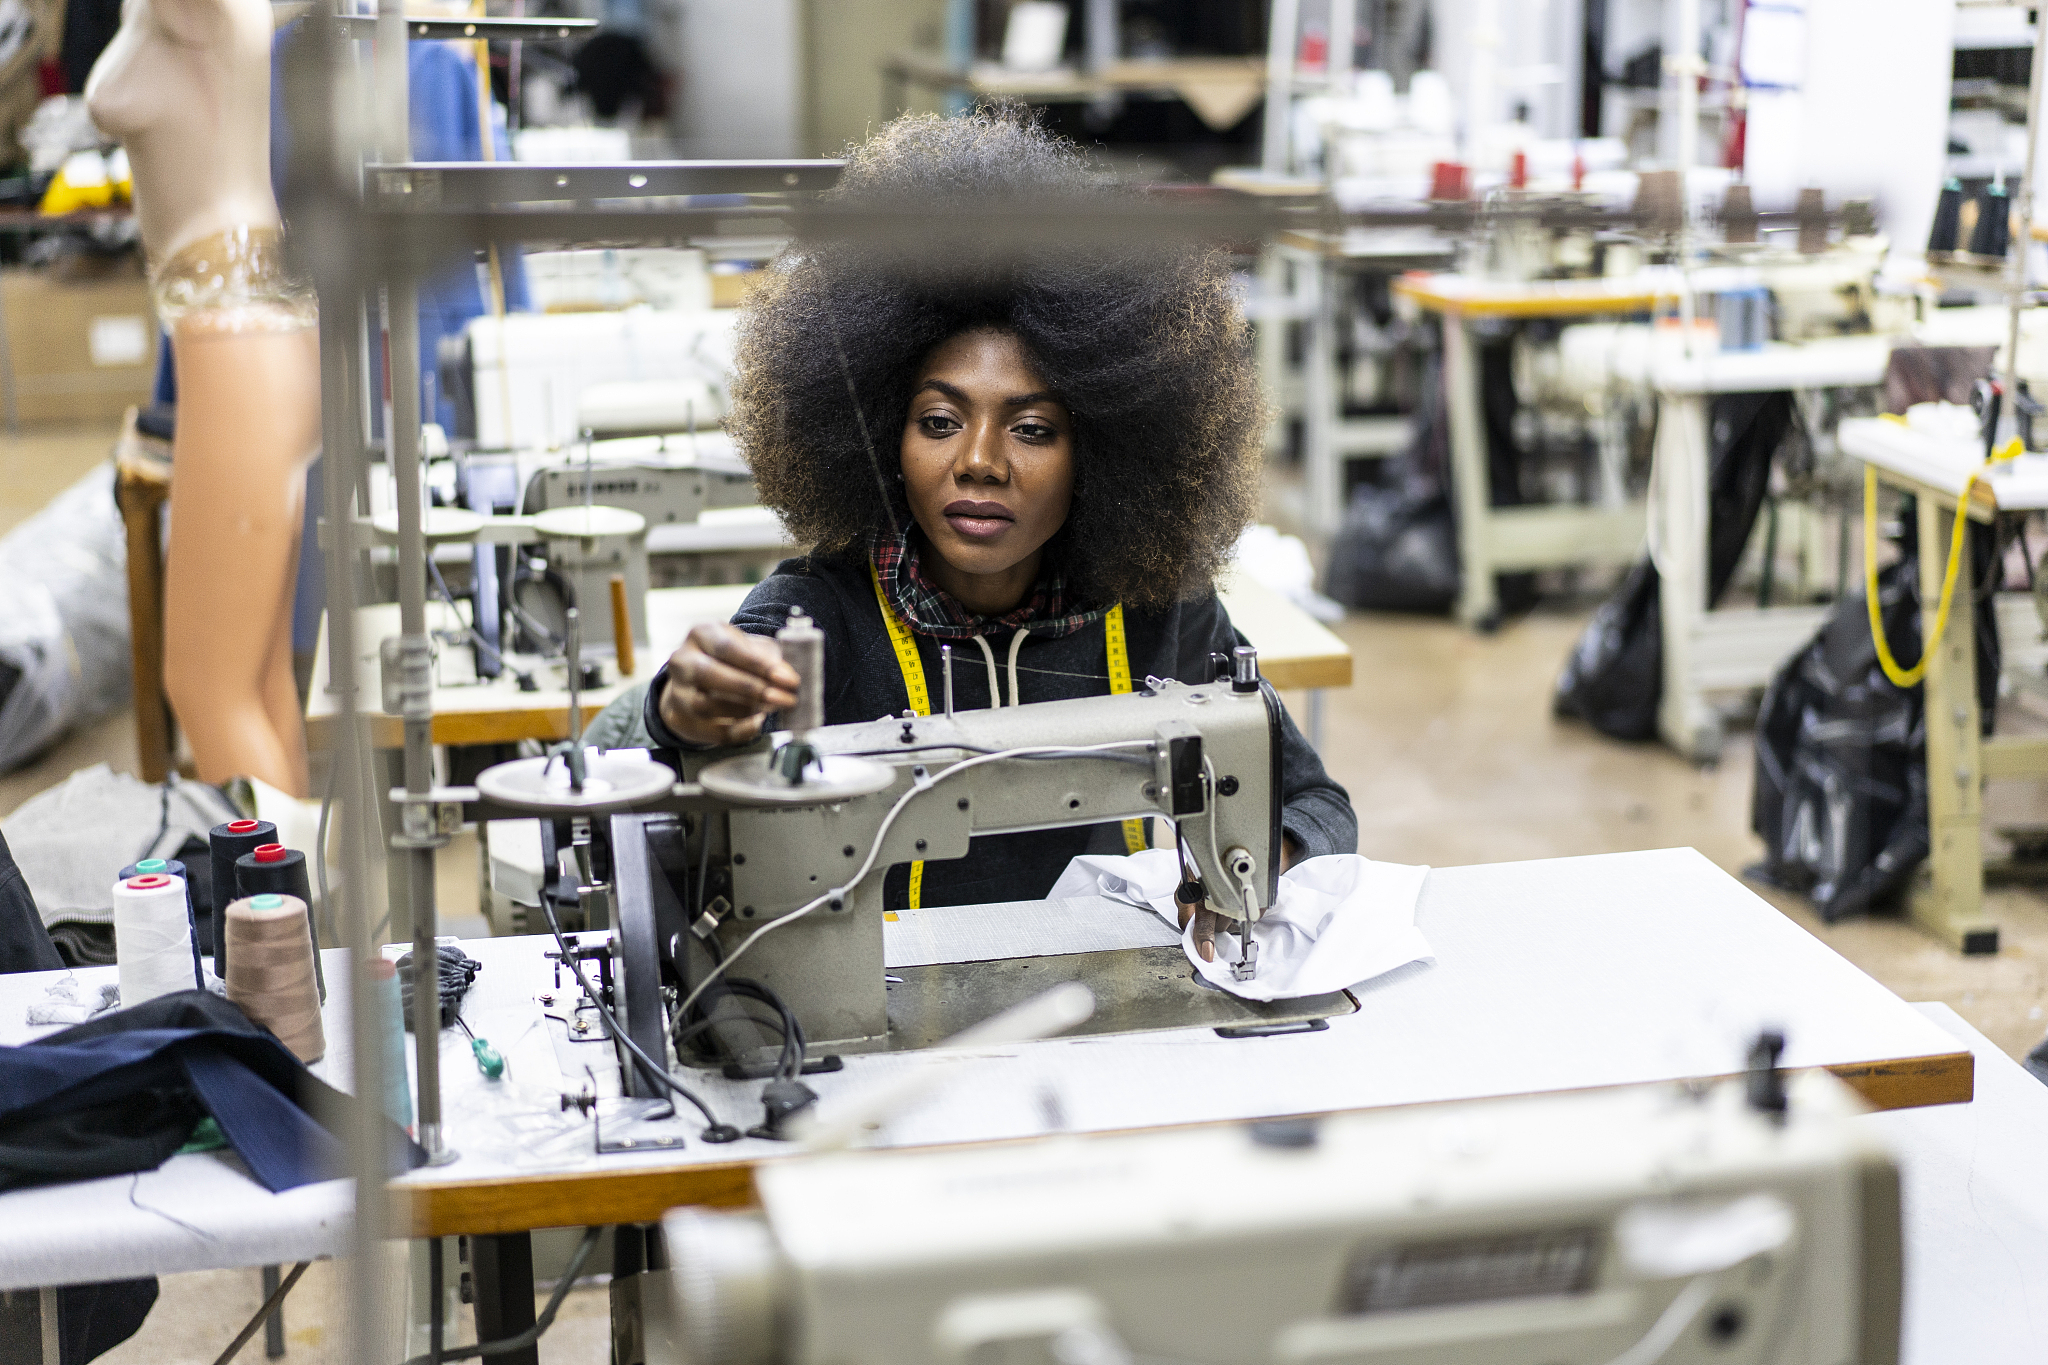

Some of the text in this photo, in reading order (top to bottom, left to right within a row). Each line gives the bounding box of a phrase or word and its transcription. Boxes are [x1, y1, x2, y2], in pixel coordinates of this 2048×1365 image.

[897, 626, 905, 634] 51
[904, 649, 912, 657] 49
[908, 661, 915, 669] 48
